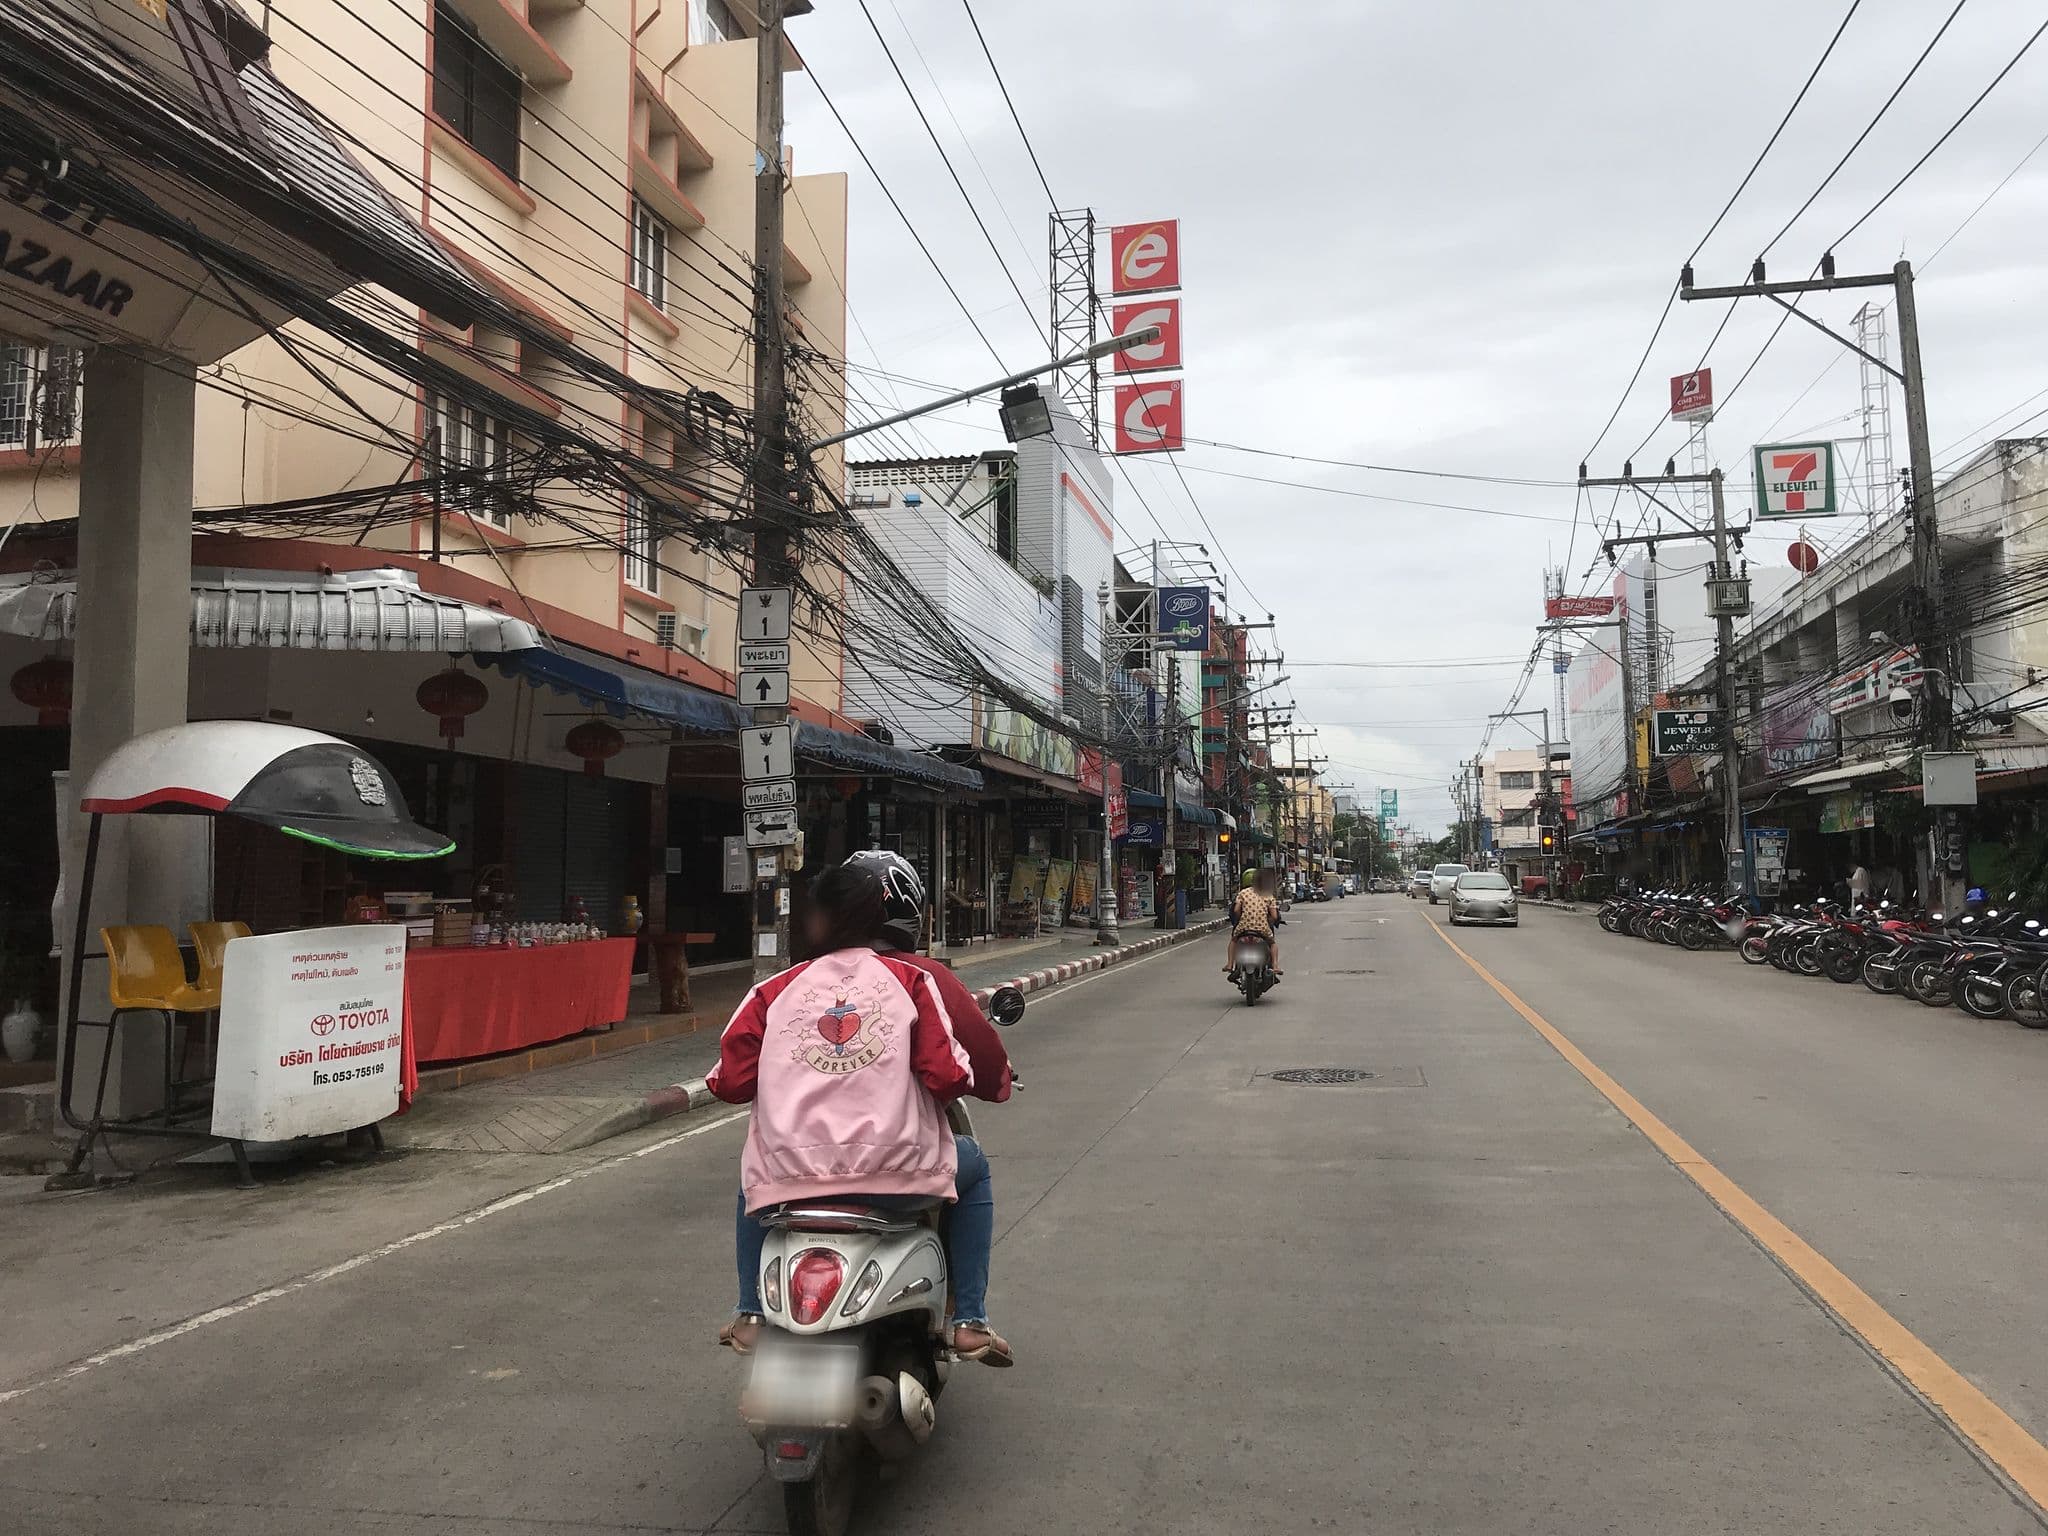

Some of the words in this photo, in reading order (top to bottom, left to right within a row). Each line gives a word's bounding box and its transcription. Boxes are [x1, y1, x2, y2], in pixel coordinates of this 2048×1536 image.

[1773, 452, 1817, 511] 7
[1170, 597, 1197, 612] Boots
[761, 616, 769, 637] 1
[744, 650, 785, 661] พะเยา
[1674, 713, 1708, 725] T.S
[1663, 726, 1716, 735] JEWELR
[1686, 733, 1698, 743] &
[763, 754, 770, 774] 1
[748, 785, 791, 804] พหลโยธิน
[339, 1008, 390, 1031] TOYOTA
[279, 1048, 313, 1067] บริษัท
[318, 1040, 385, 1062] โตโยต้าเชียงราย
[813, 1049, 876, 1072] FOREVER
[332, 1062, 385, 1083] 053-755199
